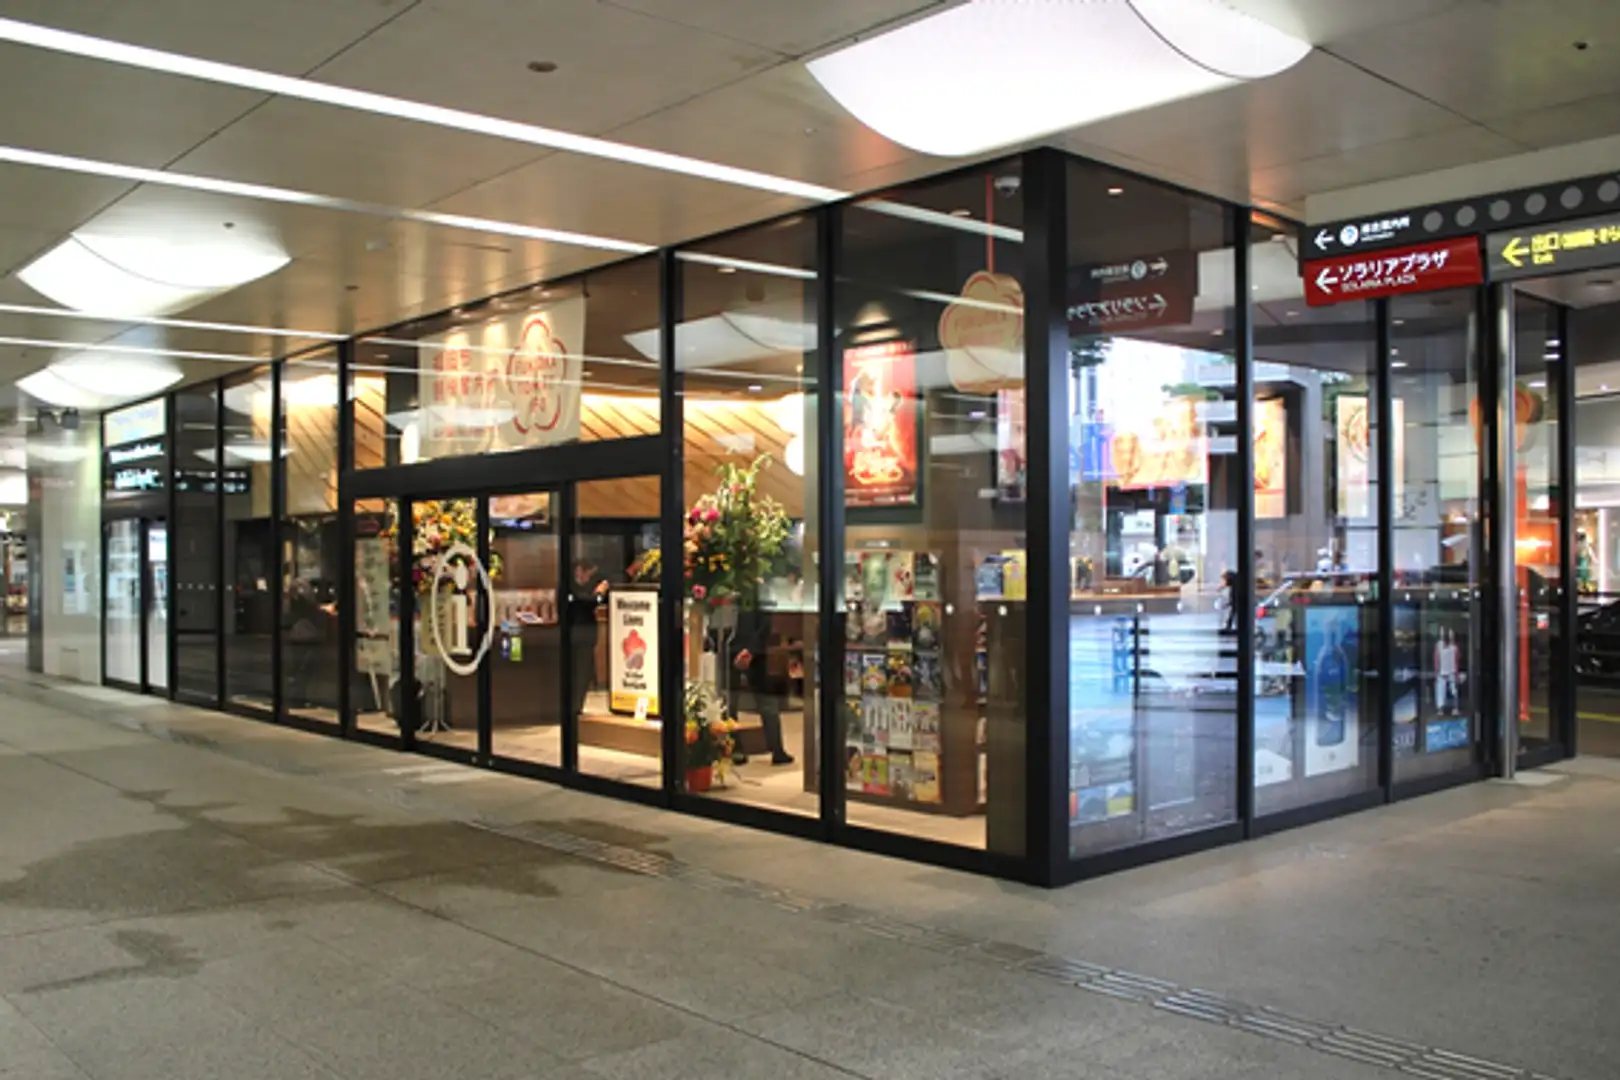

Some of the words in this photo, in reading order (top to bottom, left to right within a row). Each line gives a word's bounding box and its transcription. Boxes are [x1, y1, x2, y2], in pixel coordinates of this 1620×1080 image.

[1338, 249, 1449, 282] ソラリアプラザ
